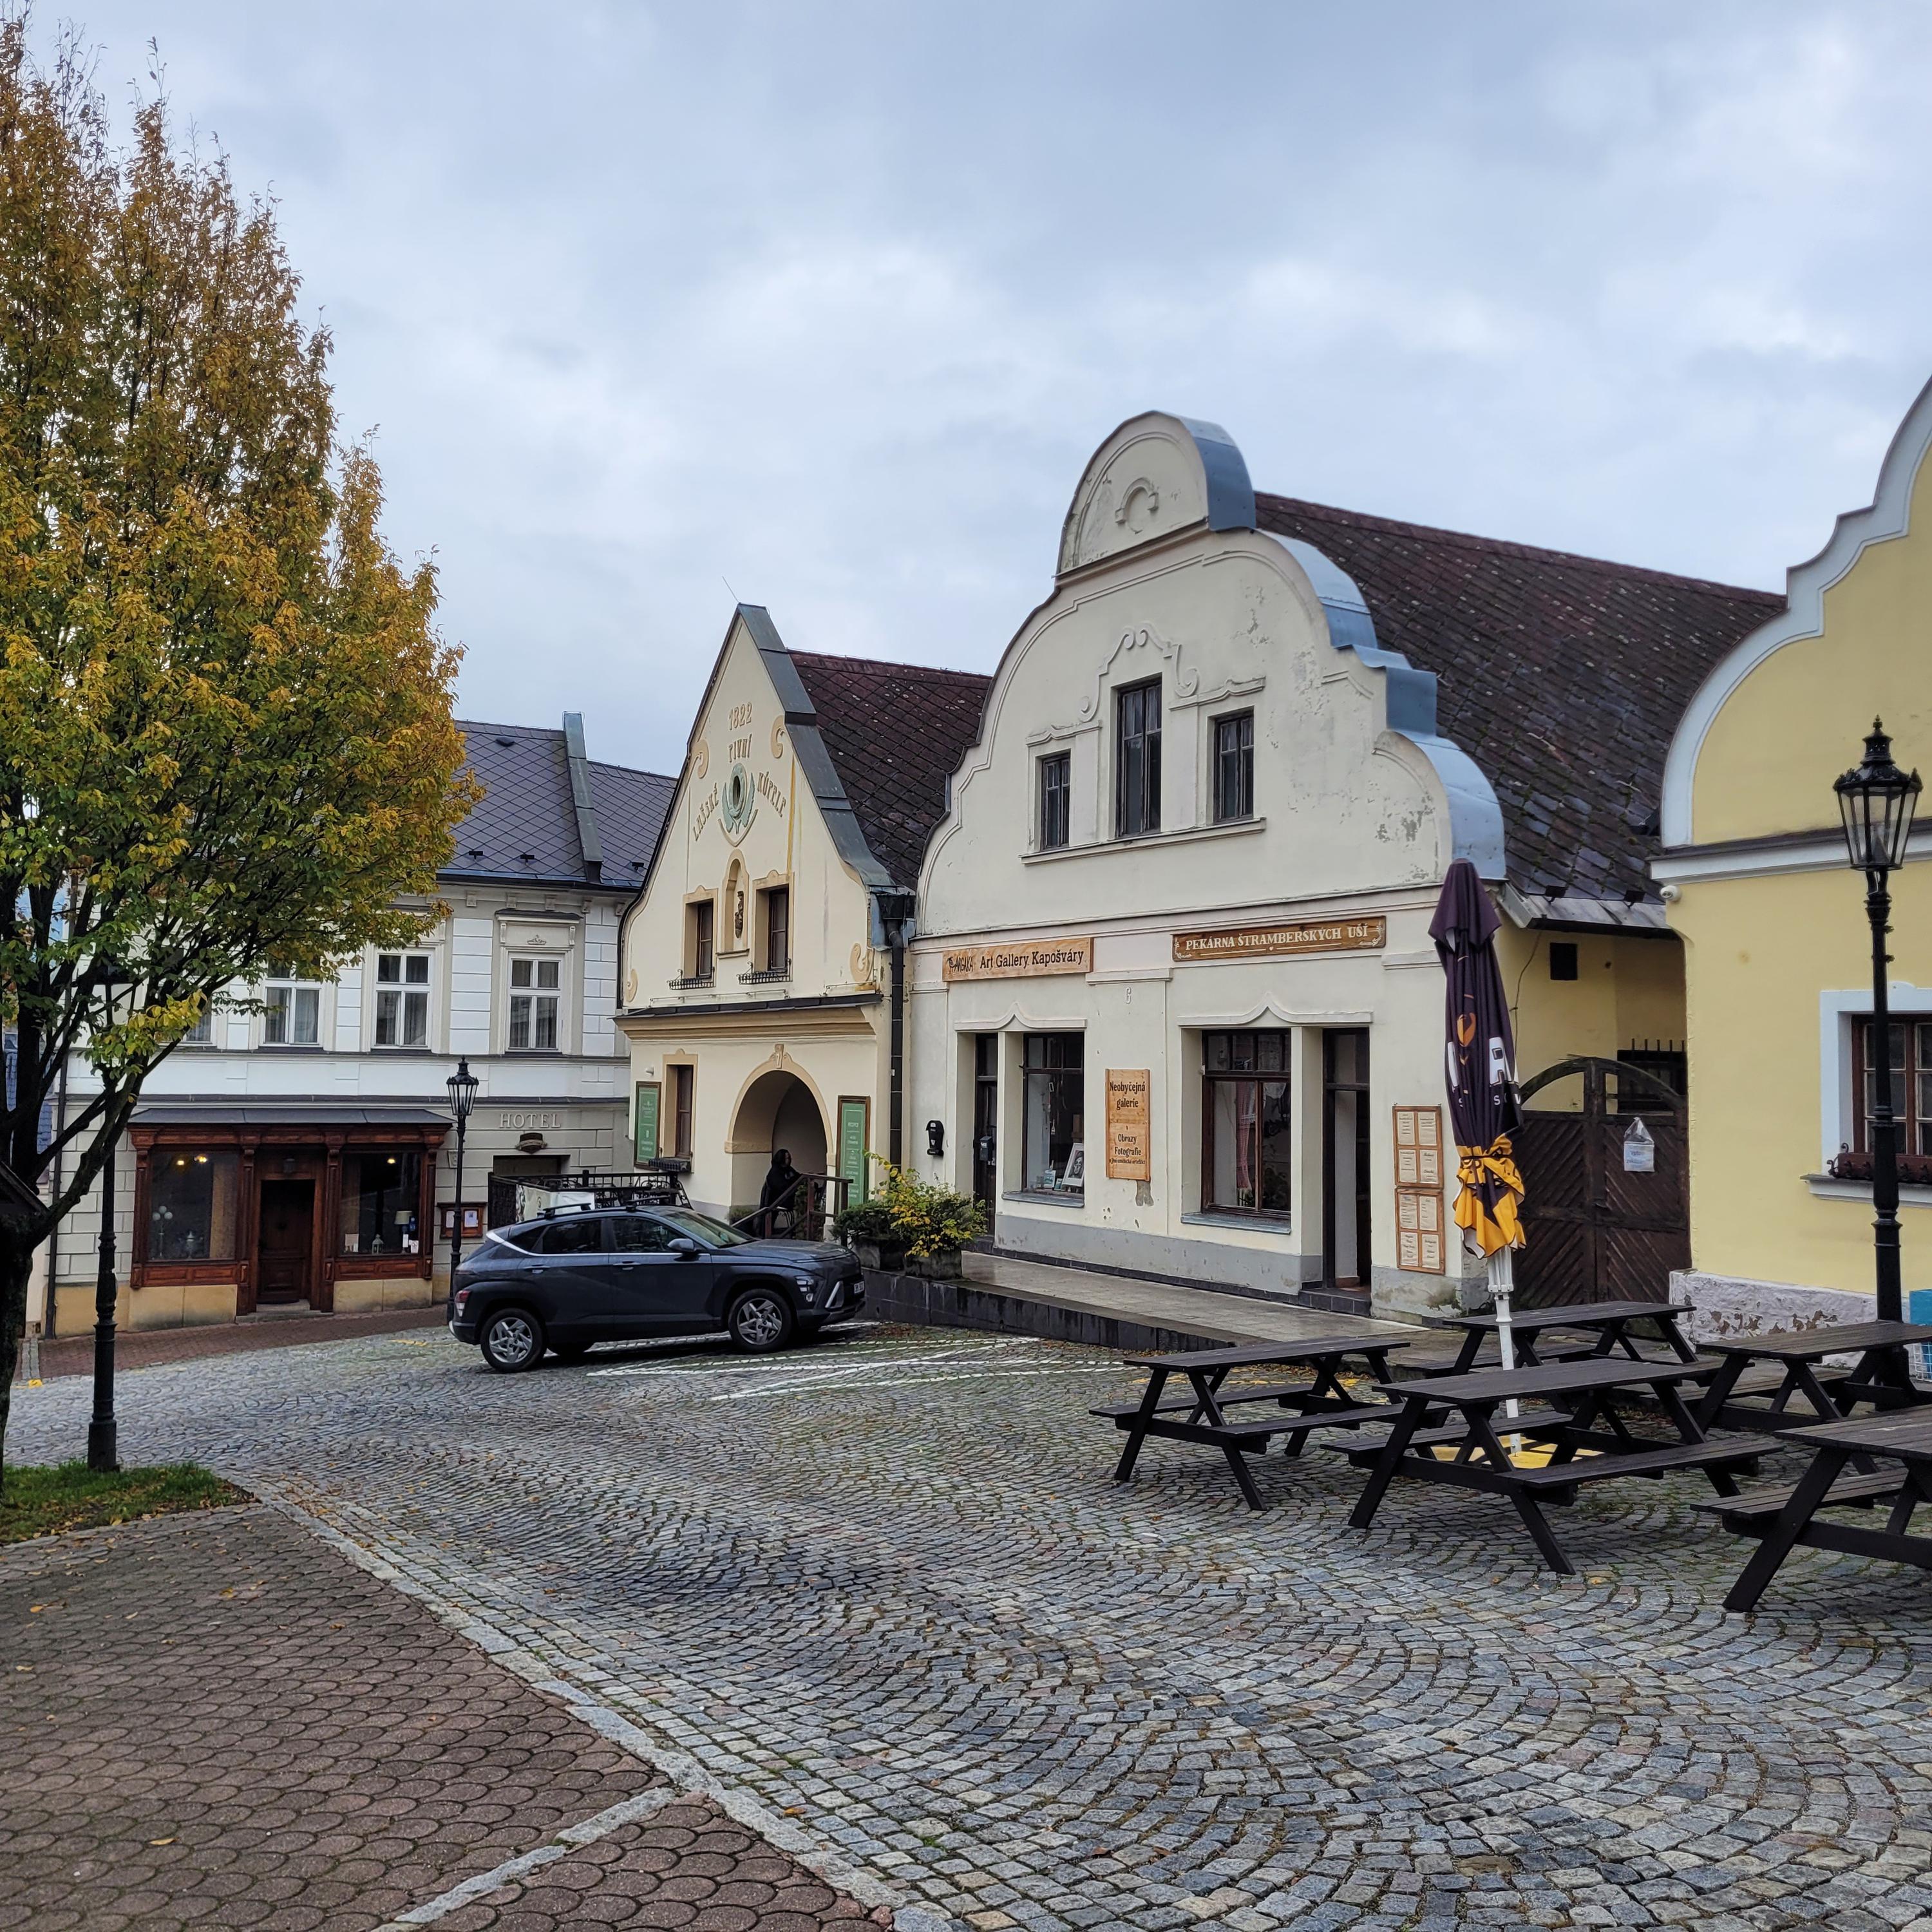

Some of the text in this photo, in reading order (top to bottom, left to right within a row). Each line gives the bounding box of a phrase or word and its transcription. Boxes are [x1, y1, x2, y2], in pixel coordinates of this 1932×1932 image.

[728, 702, 752, 730] 1822
[1185, 924, 1368, 951] PEKÁRNA ŠTRAMBERSKÝCH UŠÍ
[980, 956, 994, 969] Art
[996, 953, 1029, 969] Gallery
[1031, 948, 1084, 967] Kapošváry
[1109, 1081, 1146, 1095] Neobyčejná
[1116, 1098, 1139, 1110] galerie
[499, 1113, 562, 1128] HOTEL
[1117, 1134, 1137, 1145] Obrazy
[1114, 1146, 1141, 1158] Fotografie
